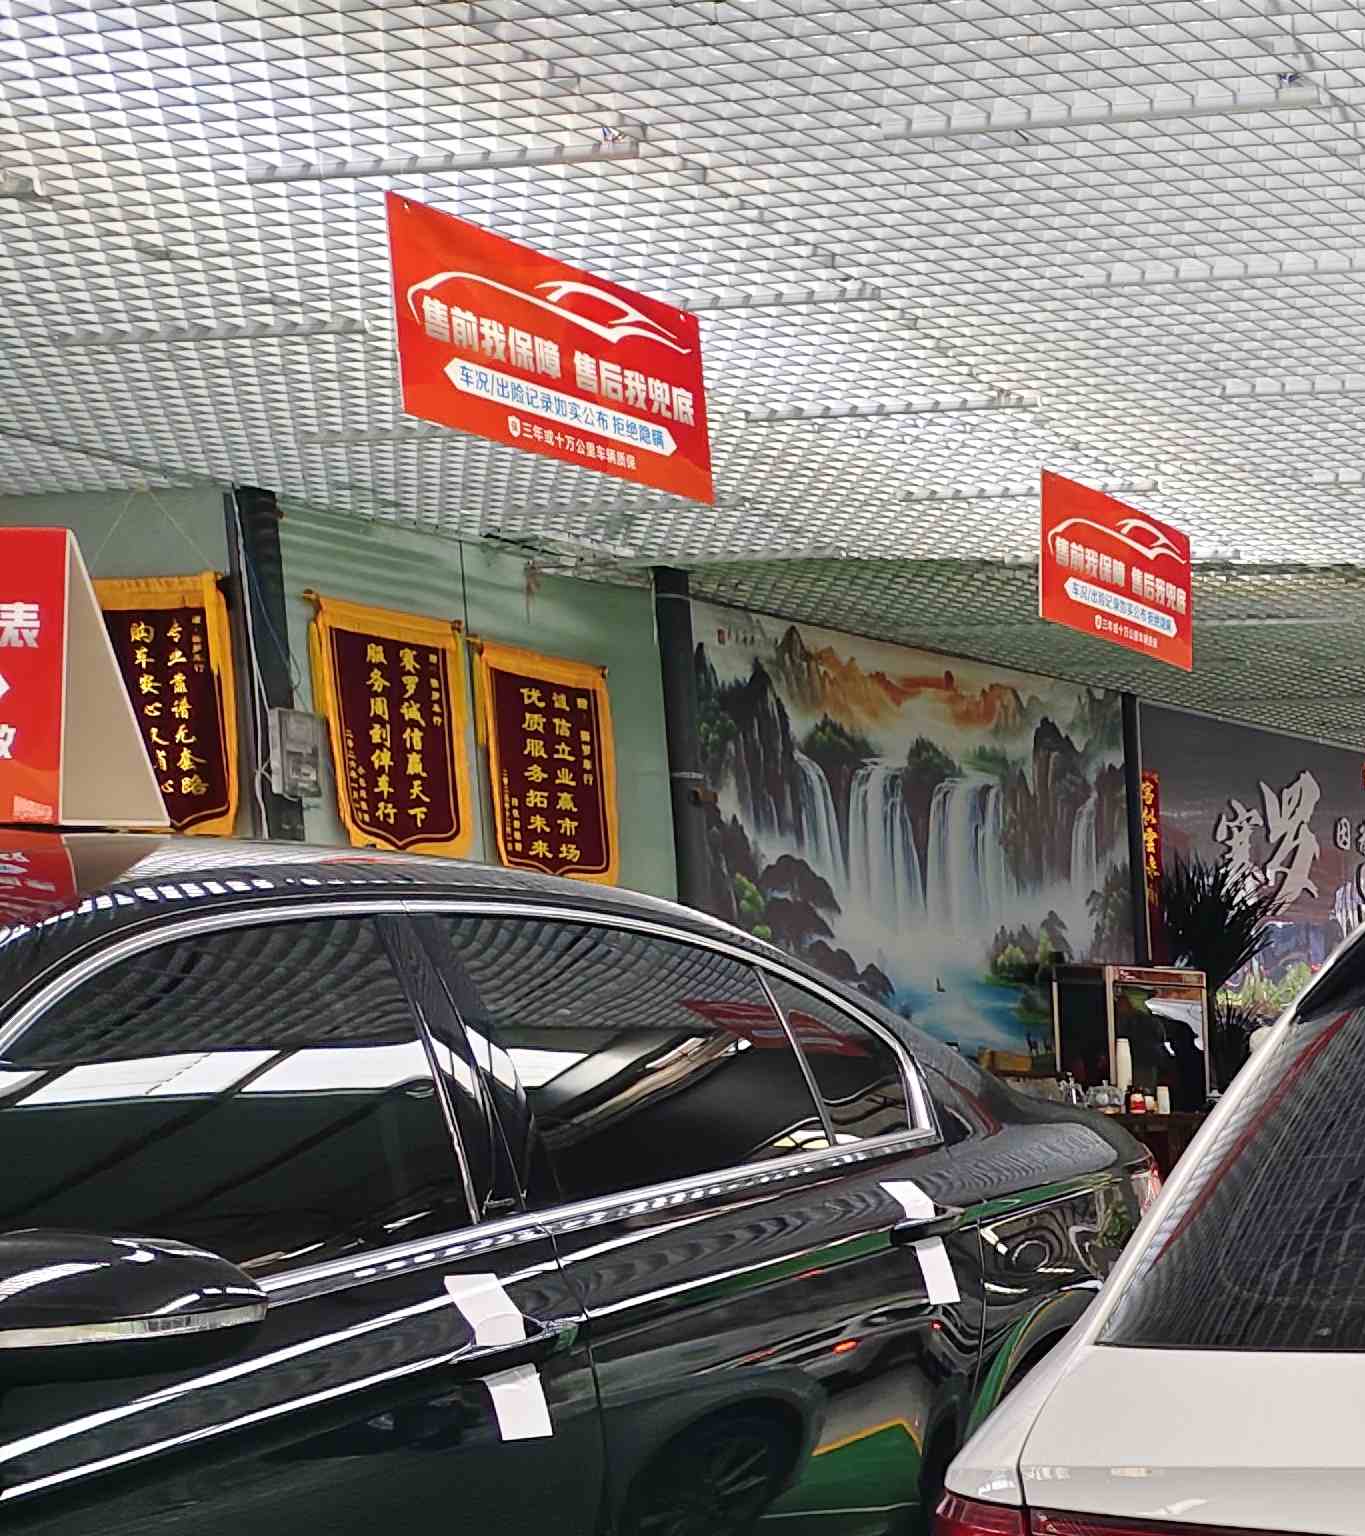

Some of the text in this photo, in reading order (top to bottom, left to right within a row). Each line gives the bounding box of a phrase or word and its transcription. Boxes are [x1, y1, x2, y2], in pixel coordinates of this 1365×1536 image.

[422, 295, 695, 426] 售前我保障 售后我兜底
[520, 687, 554, 859] 优质服务拓未来
